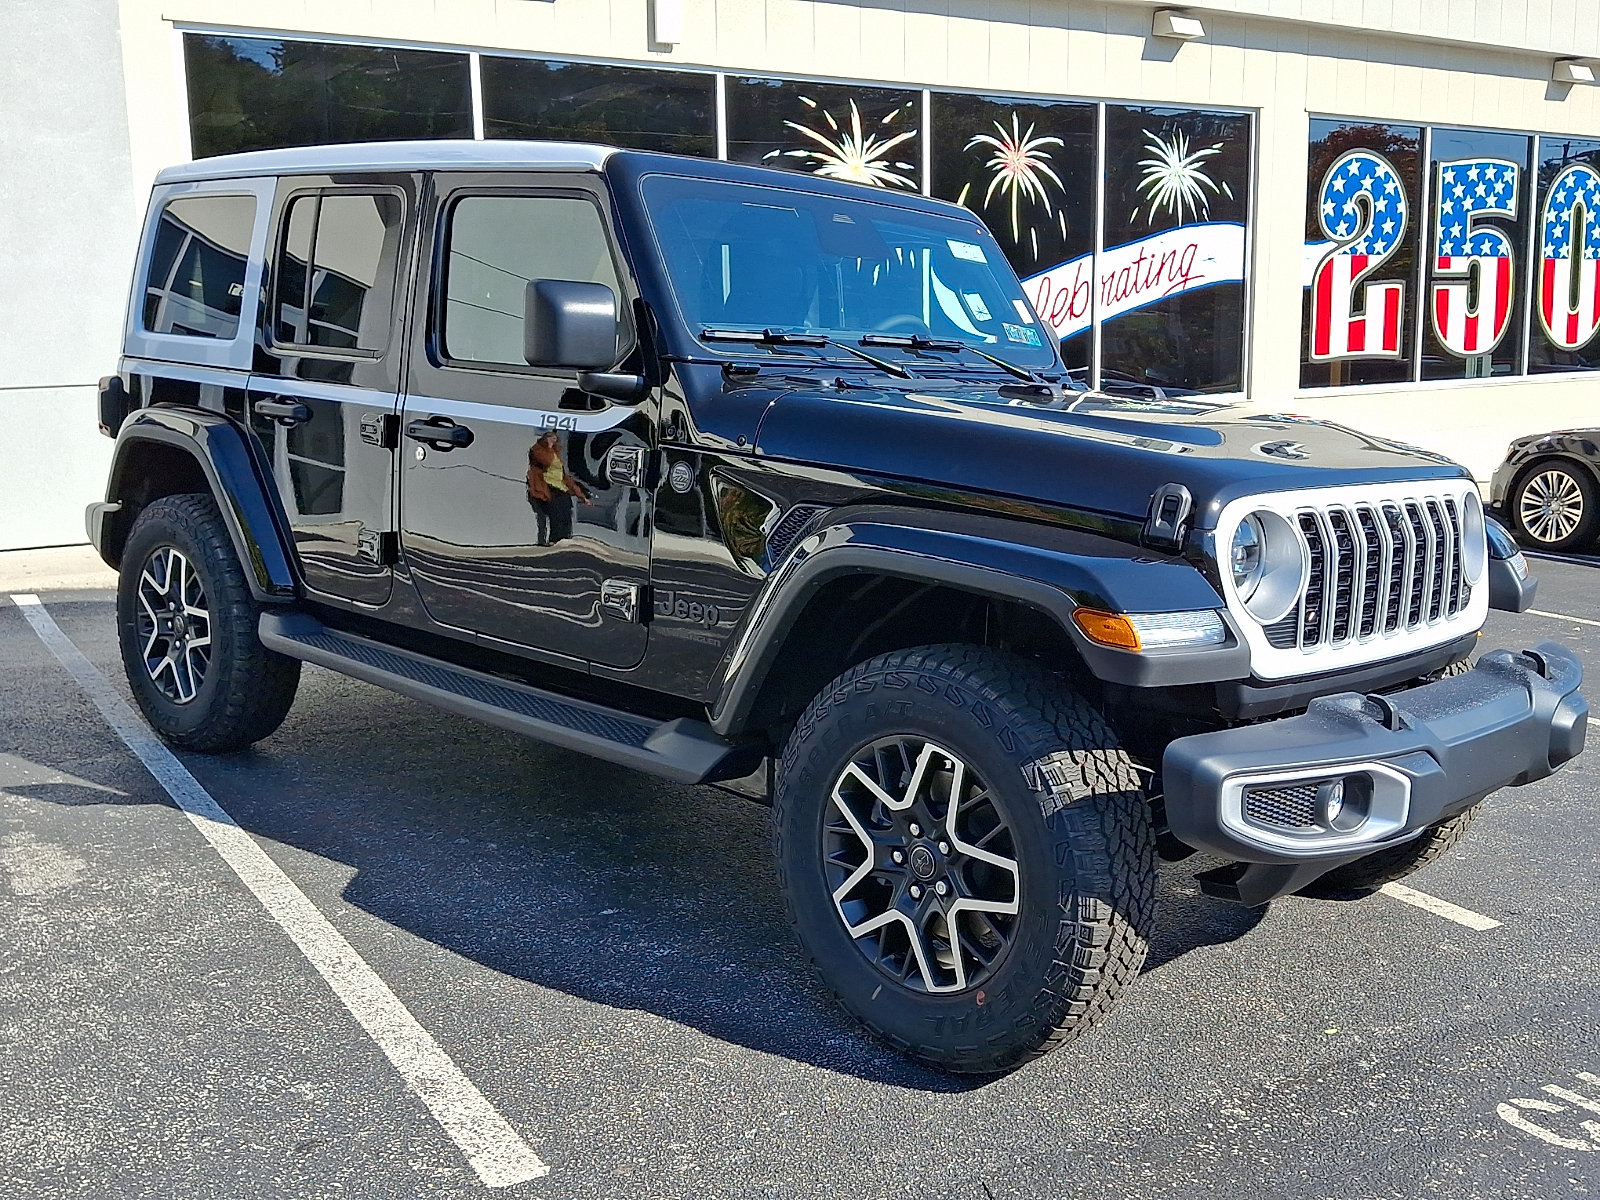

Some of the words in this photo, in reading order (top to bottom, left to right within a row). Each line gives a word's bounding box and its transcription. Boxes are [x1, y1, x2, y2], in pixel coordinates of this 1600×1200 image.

[1035, 242, 1206, 329] lebrating
[540, 413, 578, 431] 1941
[660, 590, 719, 630] Jeep
